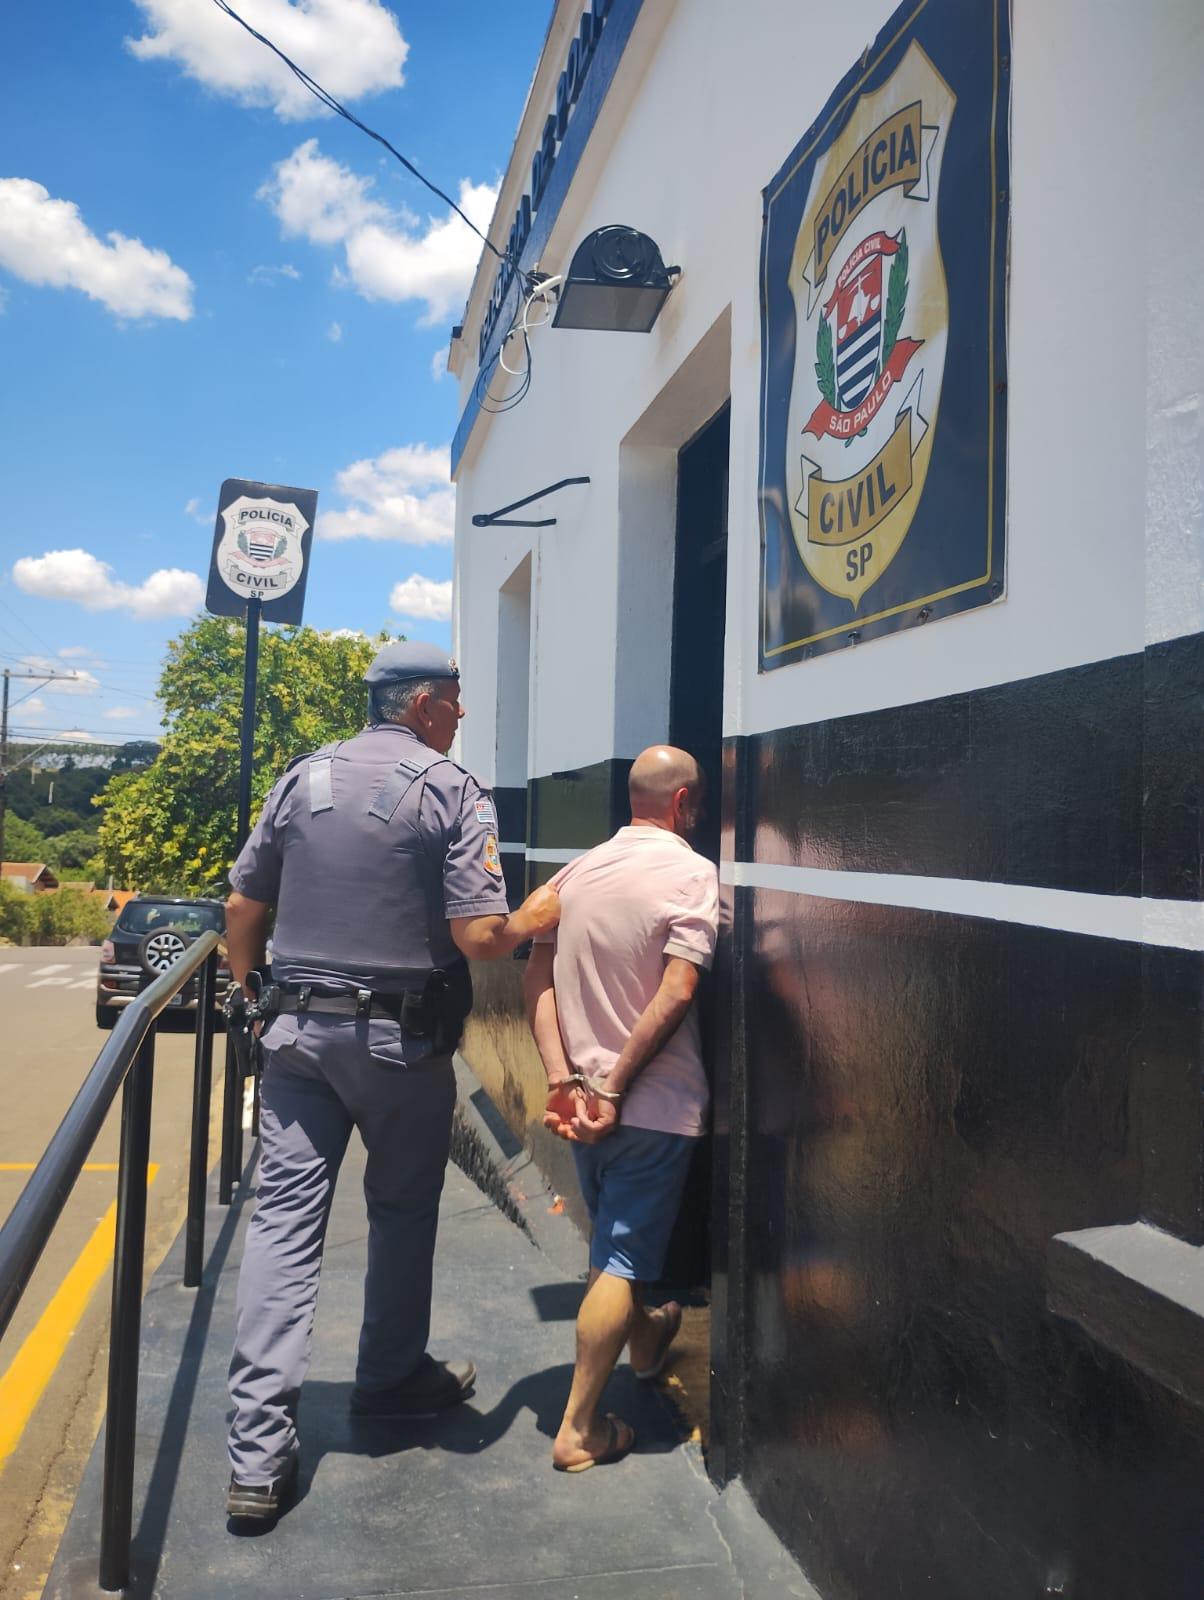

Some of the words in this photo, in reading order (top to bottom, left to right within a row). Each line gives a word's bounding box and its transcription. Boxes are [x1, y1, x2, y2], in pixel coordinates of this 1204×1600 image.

[829, 414, 850, 432] SÃO
[854, 371, 891, 429] PAULO
[820, 462, 896, 534] CIVIL
[236, 572, 278, 587] CIVIL
[846, 542, 873, 582] SP
[250, 590, 264, 598] SP
